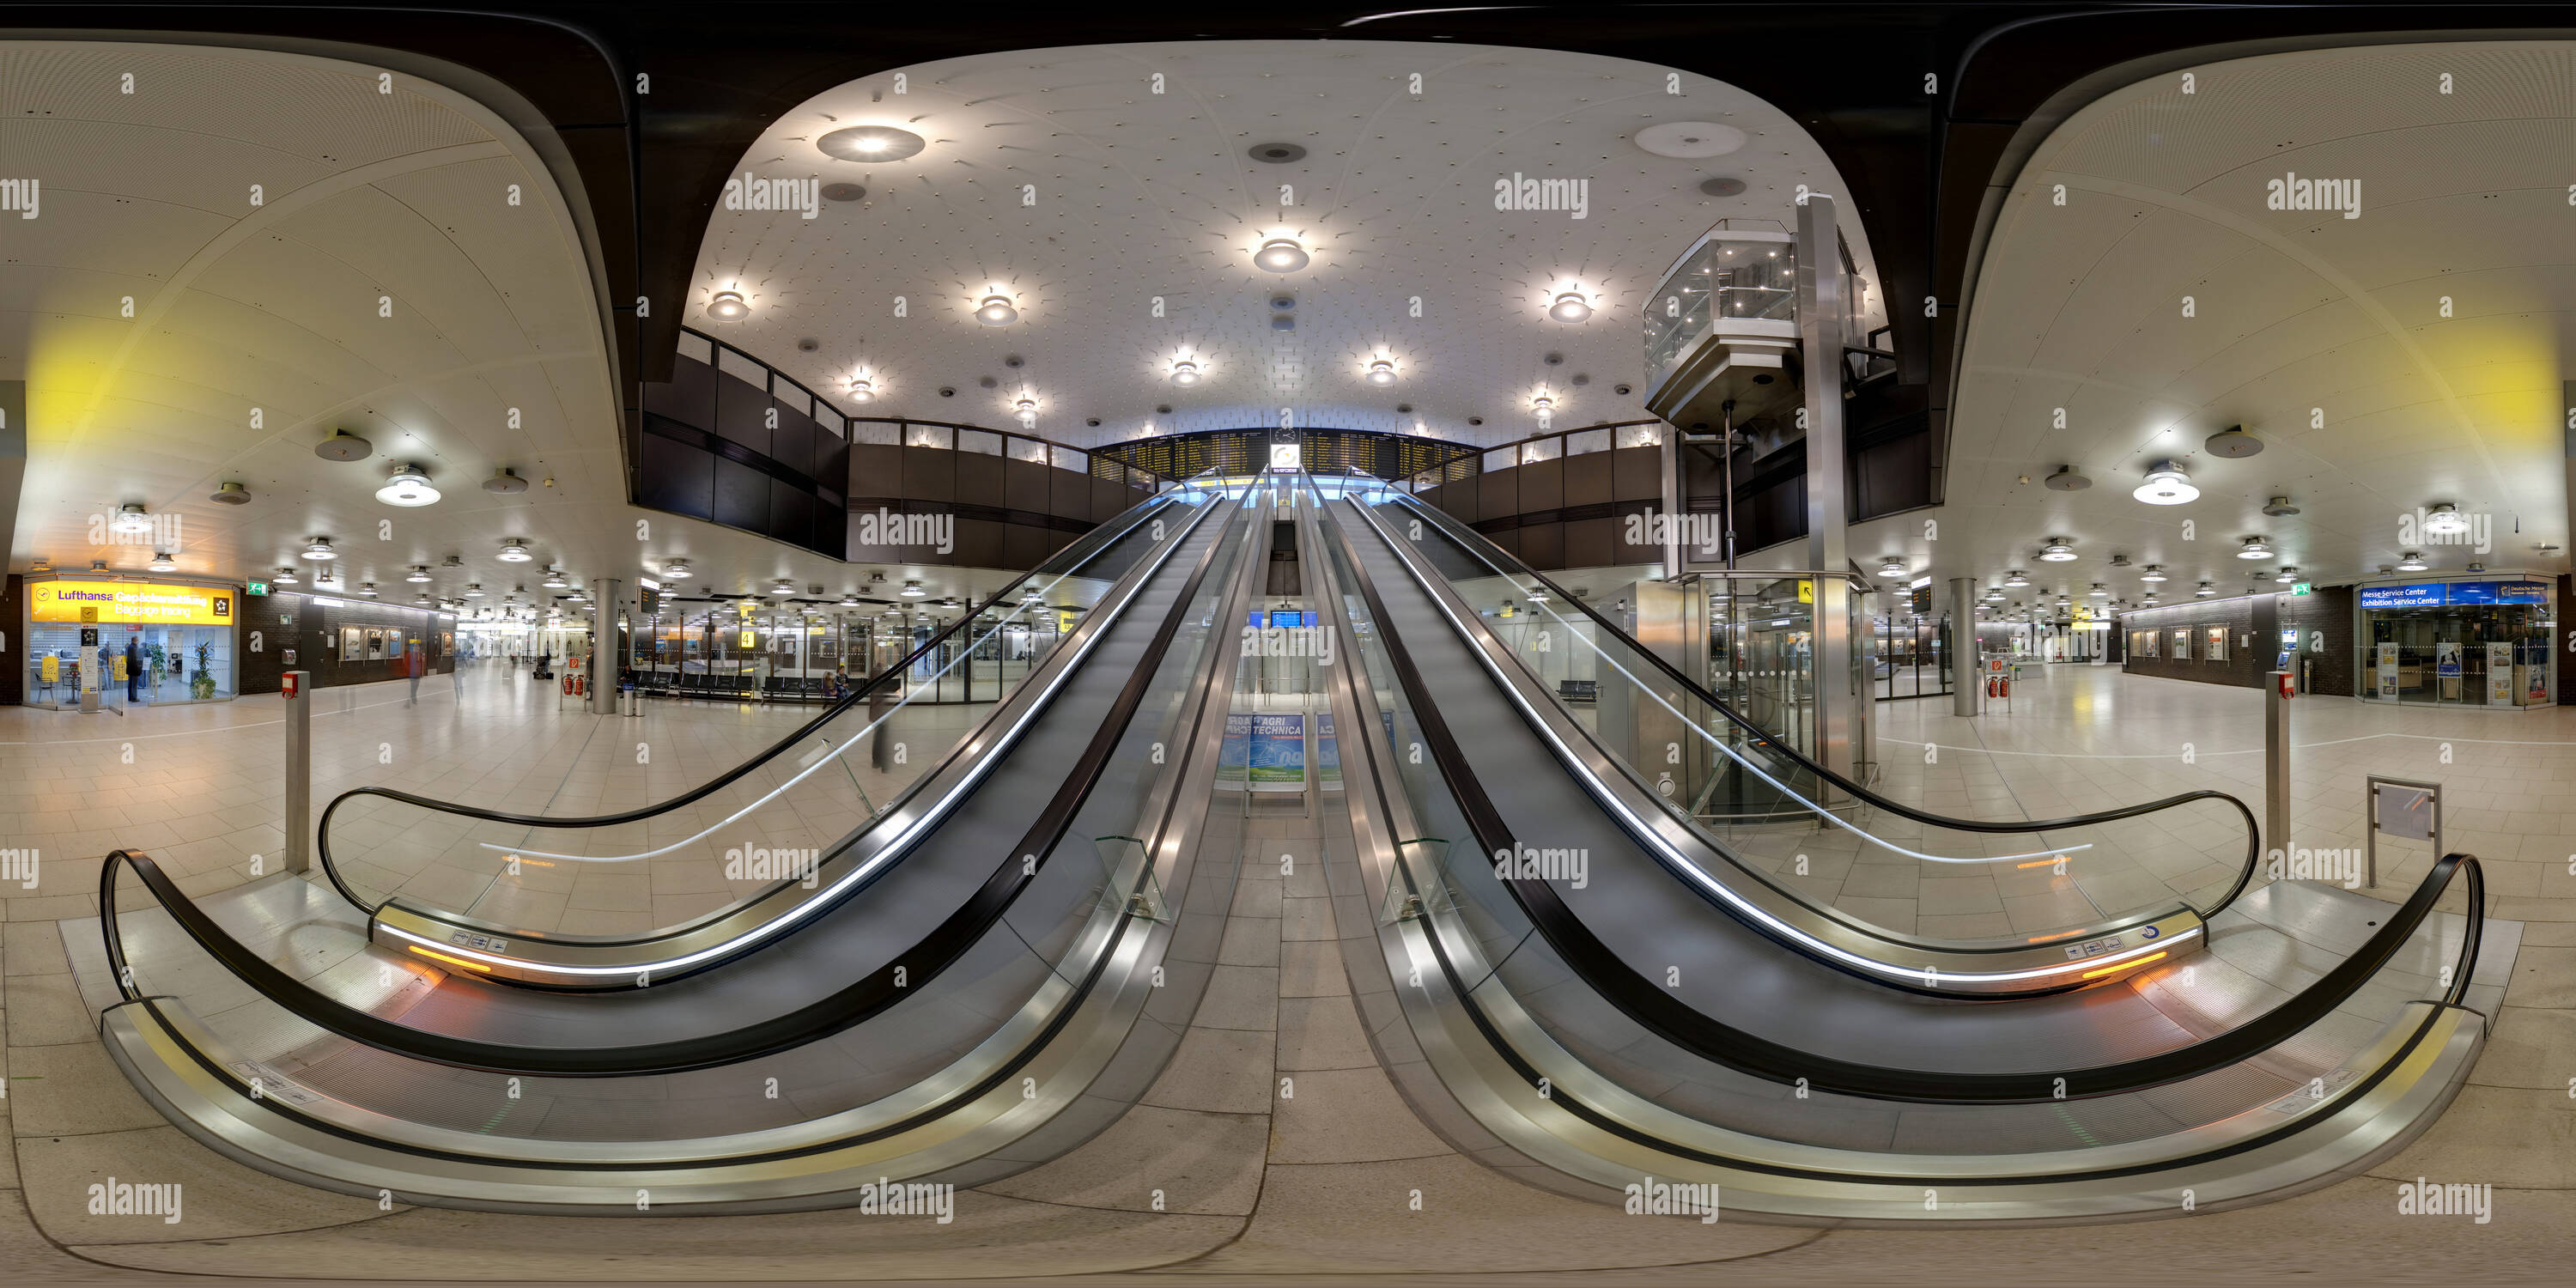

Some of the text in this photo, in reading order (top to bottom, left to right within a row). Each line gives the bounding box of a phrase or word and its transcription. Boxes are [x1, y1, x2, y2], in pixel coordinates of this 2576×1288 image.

[58, 591, 113, 601] Lufthansa
[115, 604, 159, 617] Baggage
[743, 634, 750, 645] 4
[1261, 717, 1285, 726] AGRI
[1253, 726, 1301, 735] TECHNICA
